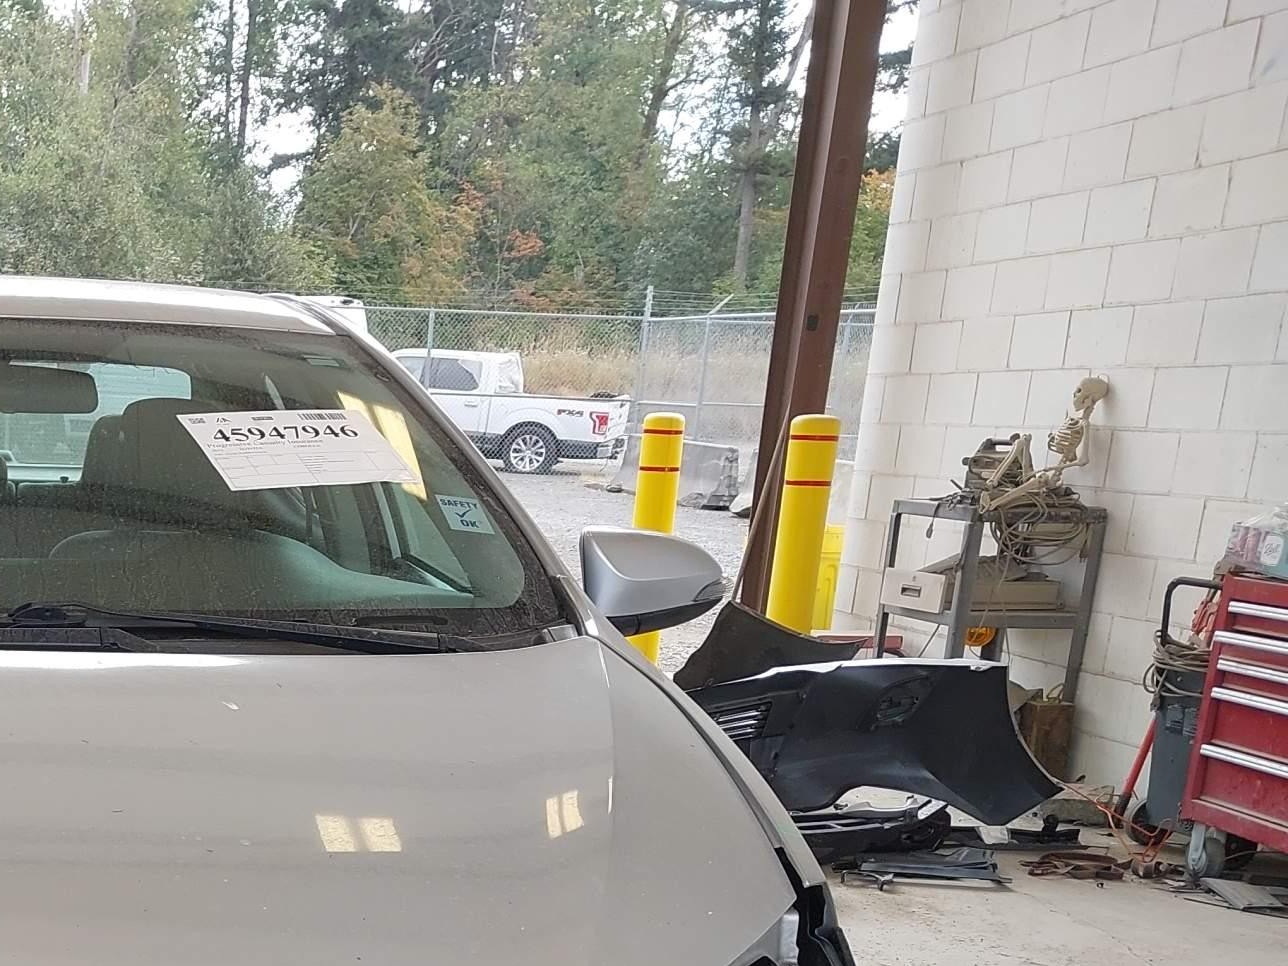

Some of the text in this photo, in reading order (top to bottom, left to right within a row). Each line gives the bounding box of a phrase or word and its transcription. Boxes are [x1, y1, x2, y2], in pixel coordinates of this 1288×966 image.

[213, 424, 359, 442] 45947946
[440, 499, 478, 509] SAFETY
[460, 519, 479, 528] OK
